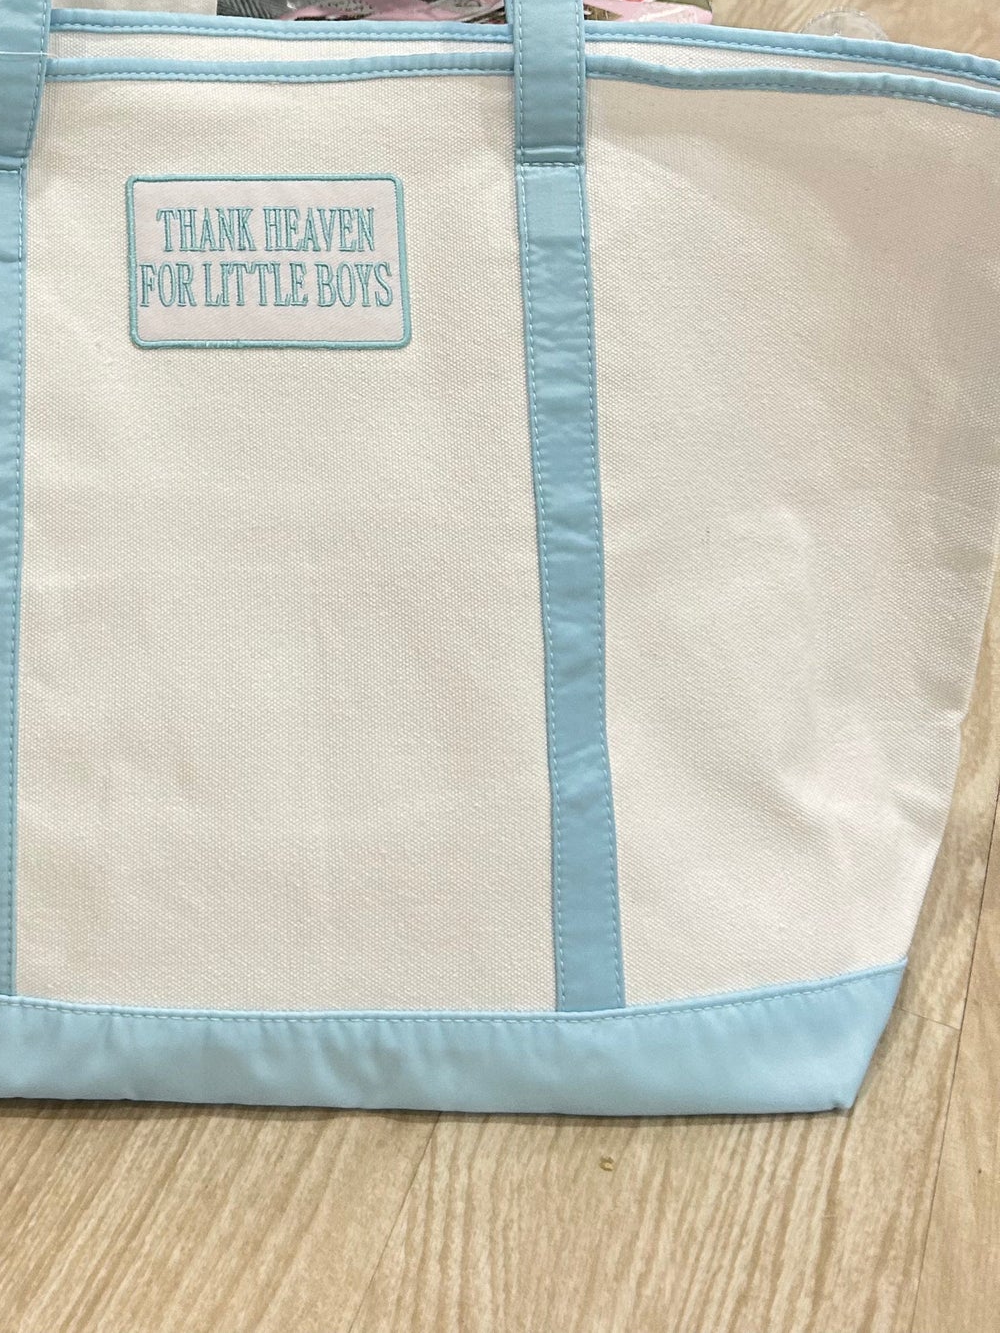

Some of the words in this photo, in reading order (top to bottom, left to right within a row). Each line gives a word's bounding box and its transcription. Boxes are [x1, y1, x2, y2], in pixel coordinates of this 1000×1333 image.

[156, 207, 256, 252] THANK
[263, 207, 375, 252] HEAVEN
[139, 262, 197, 307] FOR
[202, 262, 308, 307] LITTLE
[315, 261, 393, 307] BOYS
